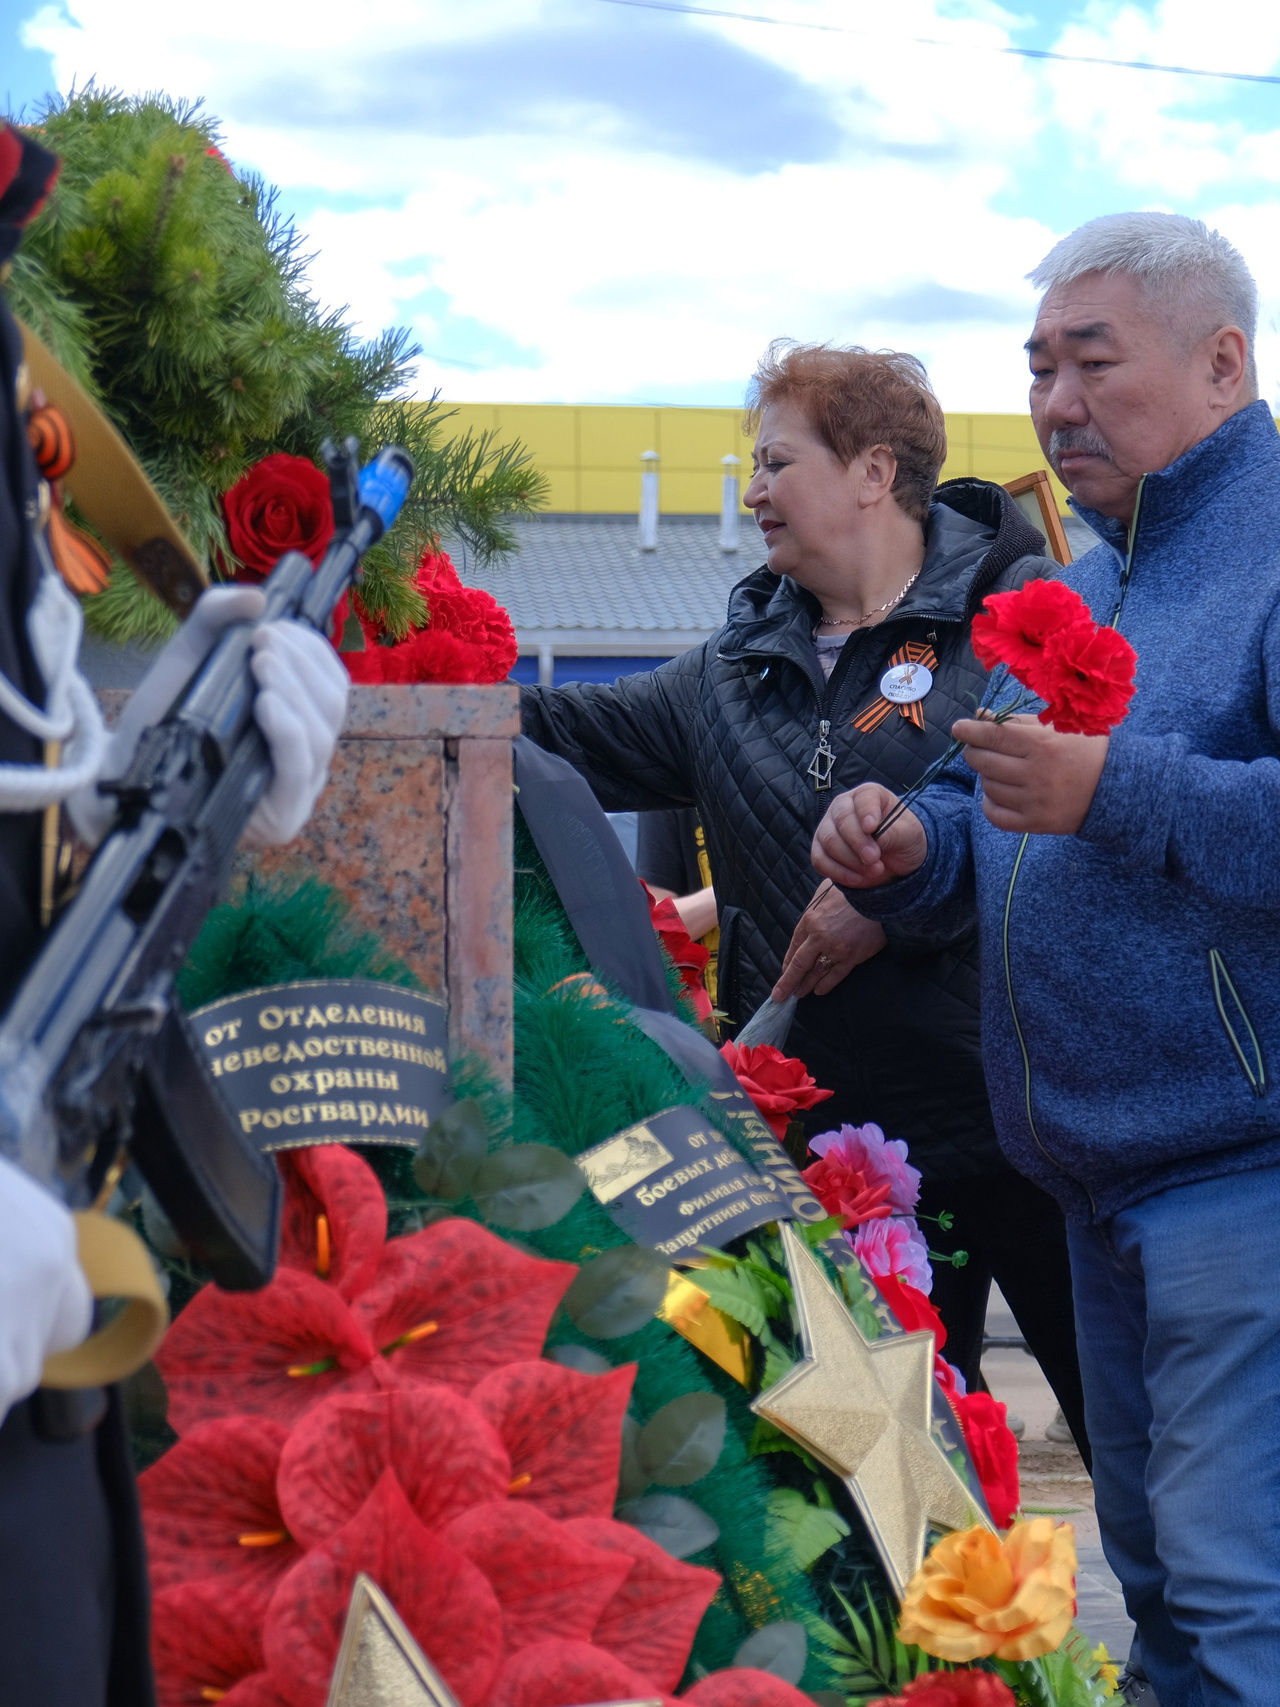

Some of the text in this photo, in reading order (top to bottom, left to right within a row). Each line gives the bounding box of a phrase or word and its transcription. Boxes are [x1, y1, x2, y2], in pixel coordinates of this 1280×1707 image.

[204, 1004, 426, 1047] от Отделения
[270, 1067, 399, 1096] охраны
[239, 1099, 429, 1133] Росгвардии
[687, 1131, 708, 1148] от
[634, 1156, 714, 1207] боевых
